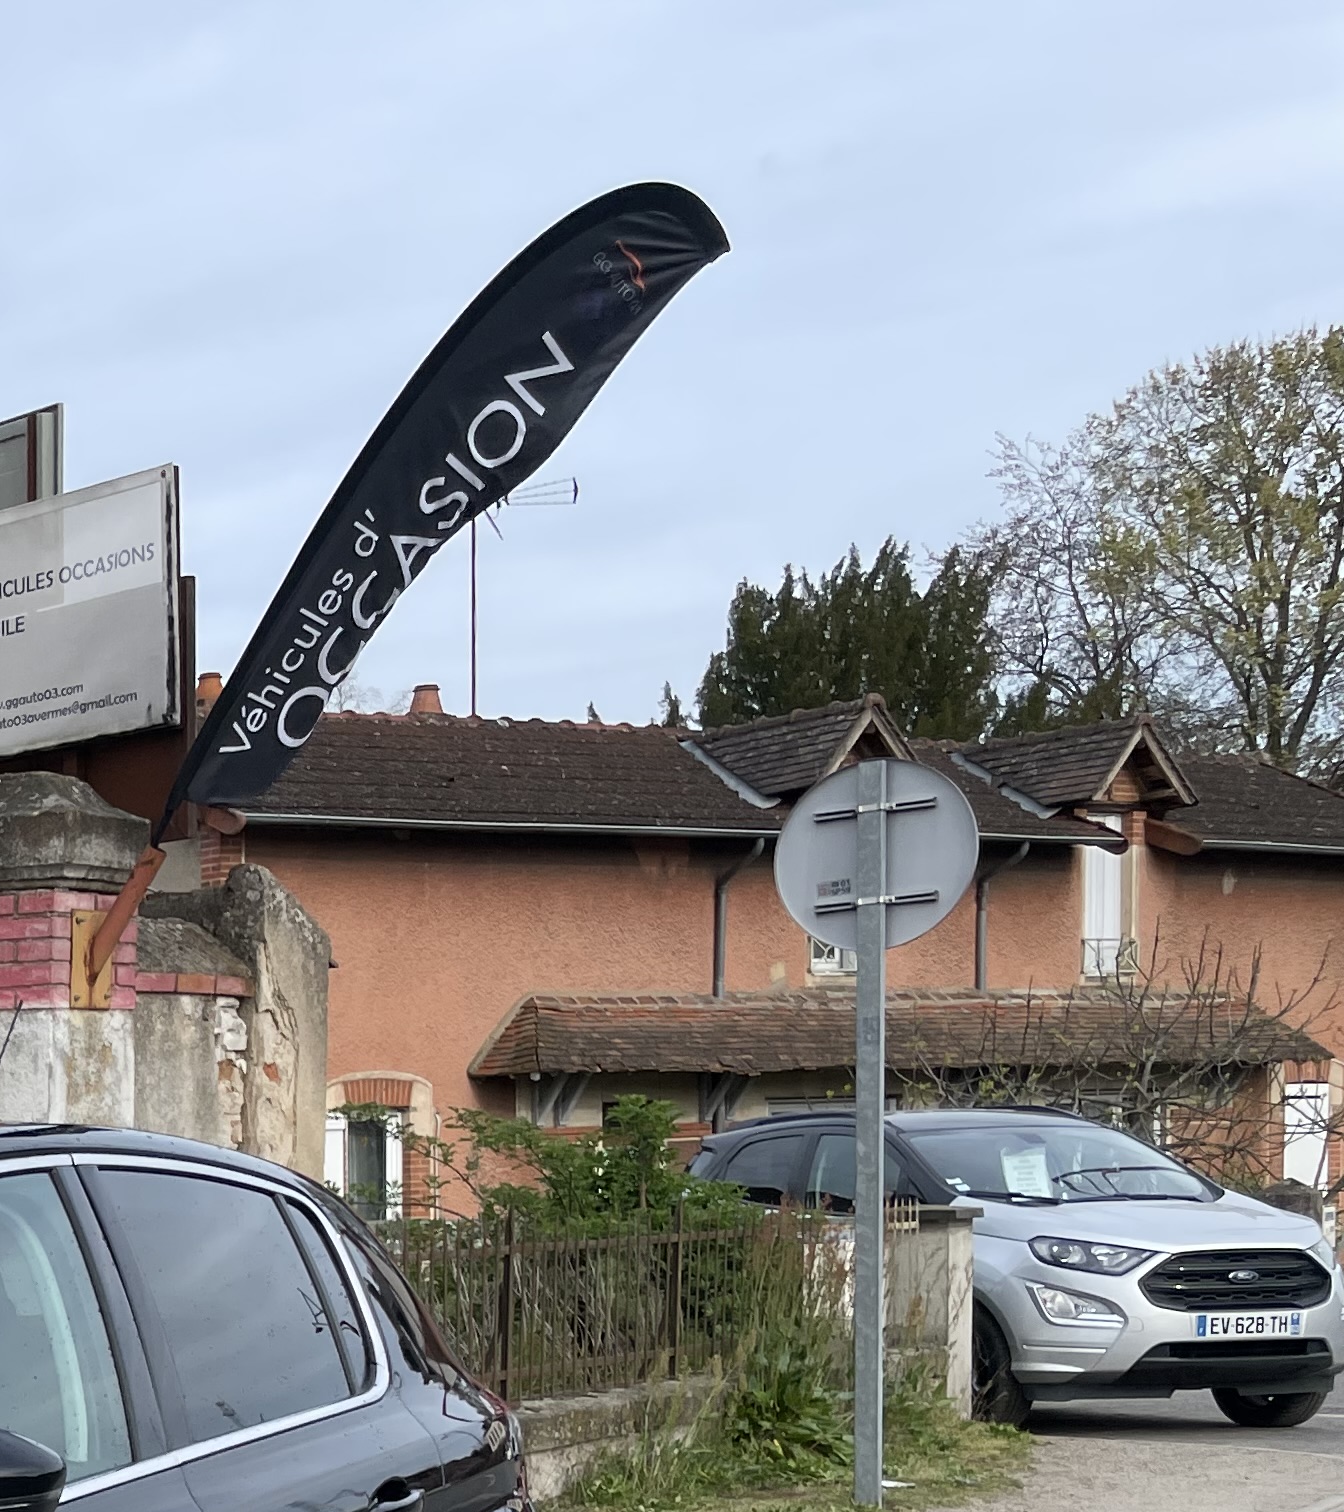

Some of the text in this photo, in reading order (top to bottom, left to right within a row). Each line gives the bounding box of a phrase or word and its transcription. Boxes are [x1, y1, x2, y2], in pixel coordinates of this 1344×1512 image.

[58, 542, 155, 584] OCCASIONS
[277, 331, 574, 748] OCCASION
[218, 568, 354, 754] Véhicules
[1210, 1315, 1289, 1335] EV-628-TH
